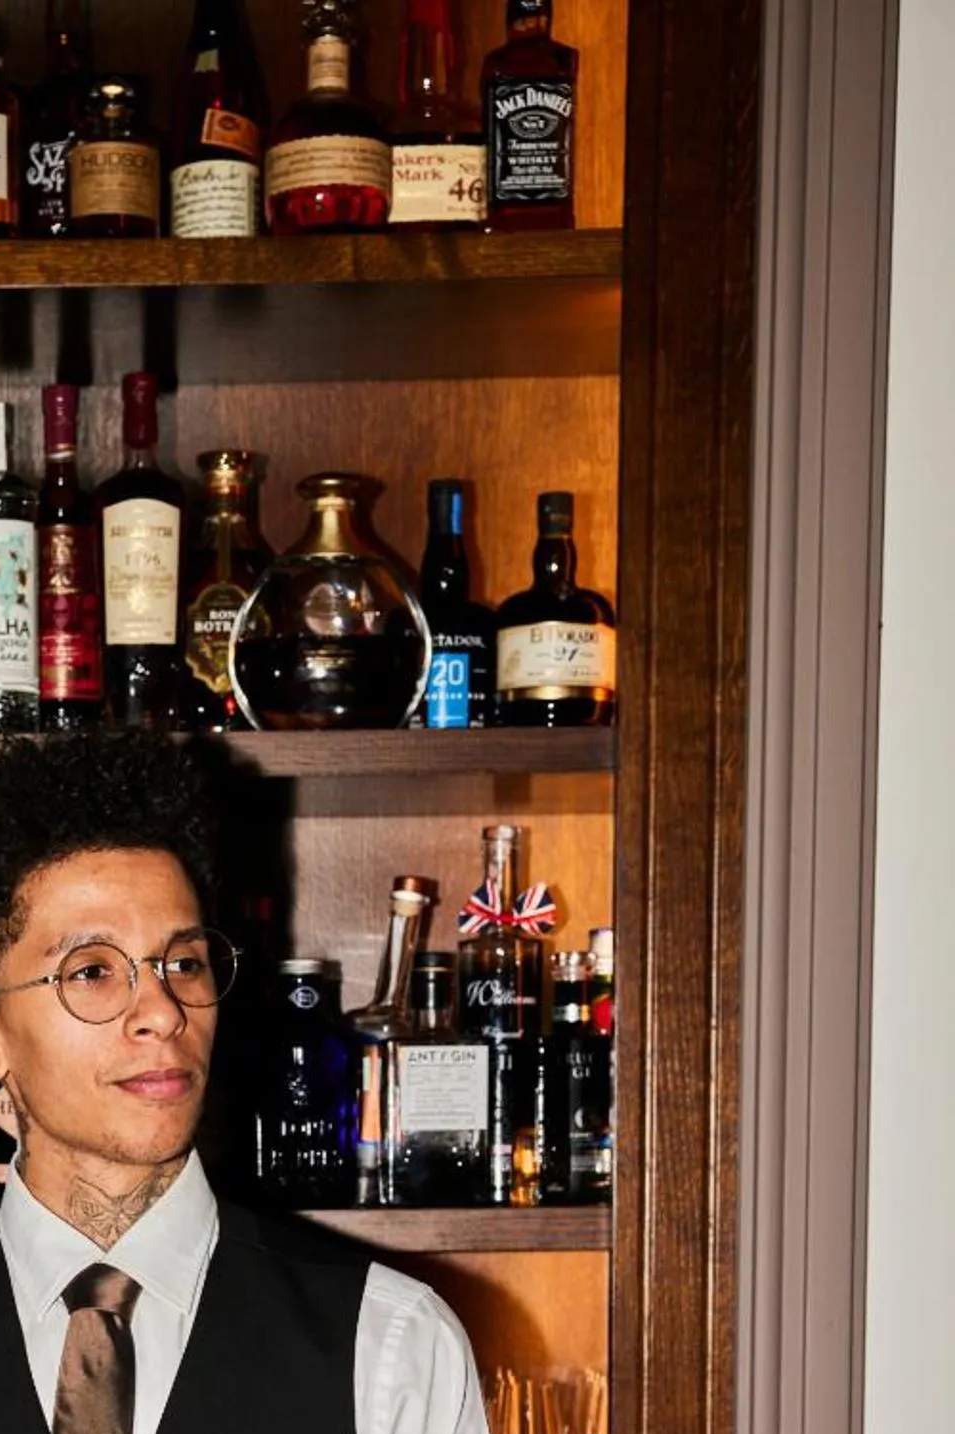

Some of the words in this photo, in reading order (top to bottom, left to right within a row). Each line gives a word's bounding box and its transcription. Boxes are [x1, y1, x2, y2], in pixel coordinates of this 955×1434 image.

[496, 94, 524, 119] JACK
[524, 87, 570, 118] DANIEL'S
[394, 168, 444, 182] Mark
[448, 177, 484, 204] 46
[431, 659, 464, 687] 20
[450, 1049, 477, 1062] GIN
